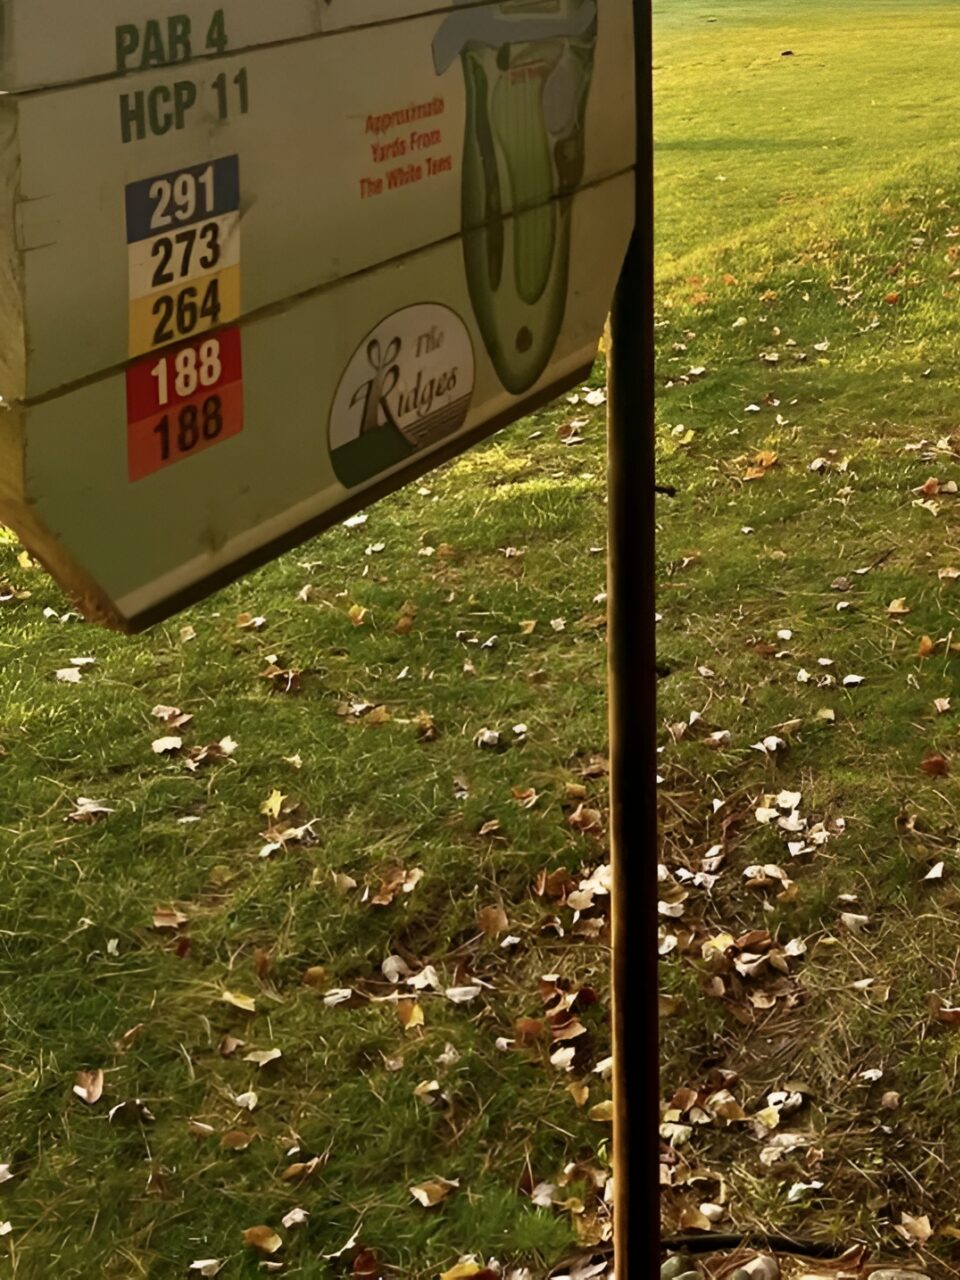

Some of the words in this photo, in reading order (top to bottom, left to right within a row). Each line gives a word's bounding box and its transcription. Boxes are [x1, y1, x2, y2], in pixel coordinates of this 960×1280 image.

[115, 14, 192, 72] PAR
[205, 8, 228, 56] 4
[119, 80, 197, 144] HCP
[211, 66, 249, 120] 11
[149, 166, 214, 230] 291
[151, 222, 221, 288] 273
[152, 278, 221, 345] 264
[151, 338, 222, 406] 188
[348, 363, 458, 438] Ridges
[153, 395, 223, 461] 188
